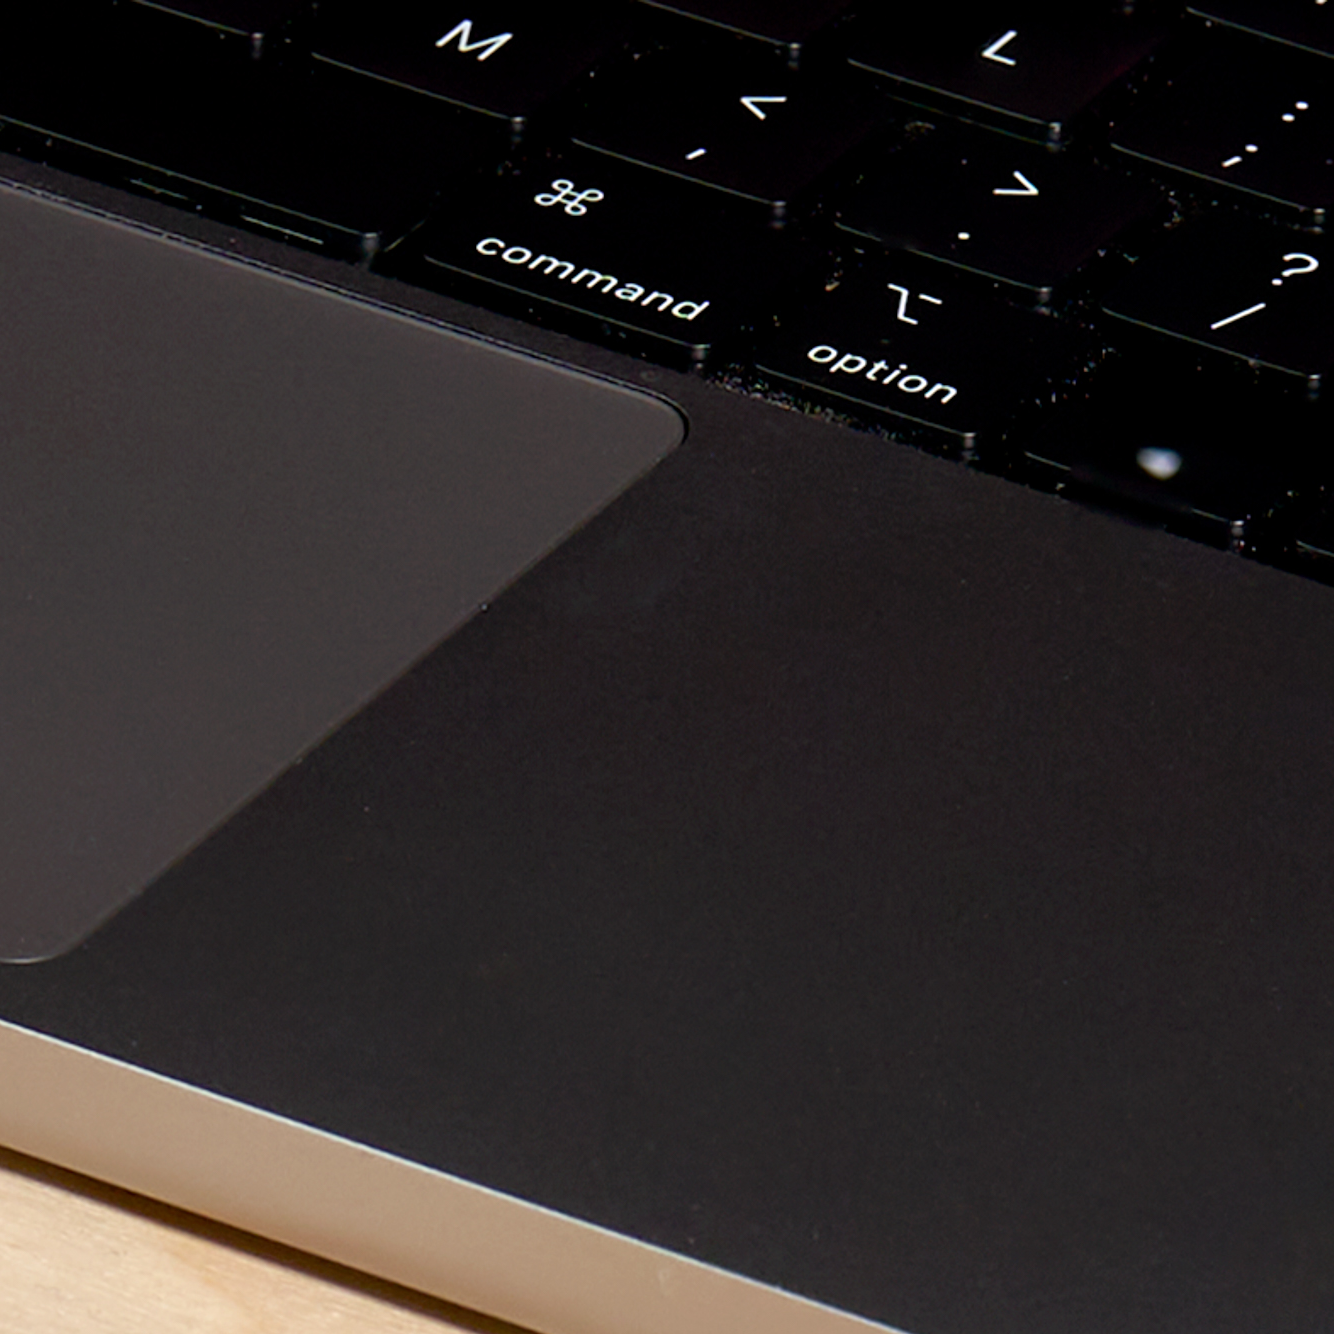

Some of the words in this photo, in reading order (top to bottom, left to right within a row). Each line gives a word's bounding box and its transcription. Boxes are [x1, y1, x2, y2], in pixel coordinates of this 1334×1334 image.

[435, 19, 513, 61] M
[982, 30, 1017, 66] L
[475, 238, 711, 322] command
[1271, 253, 1319, 286] ?
[807, 345, 958, 404] option
